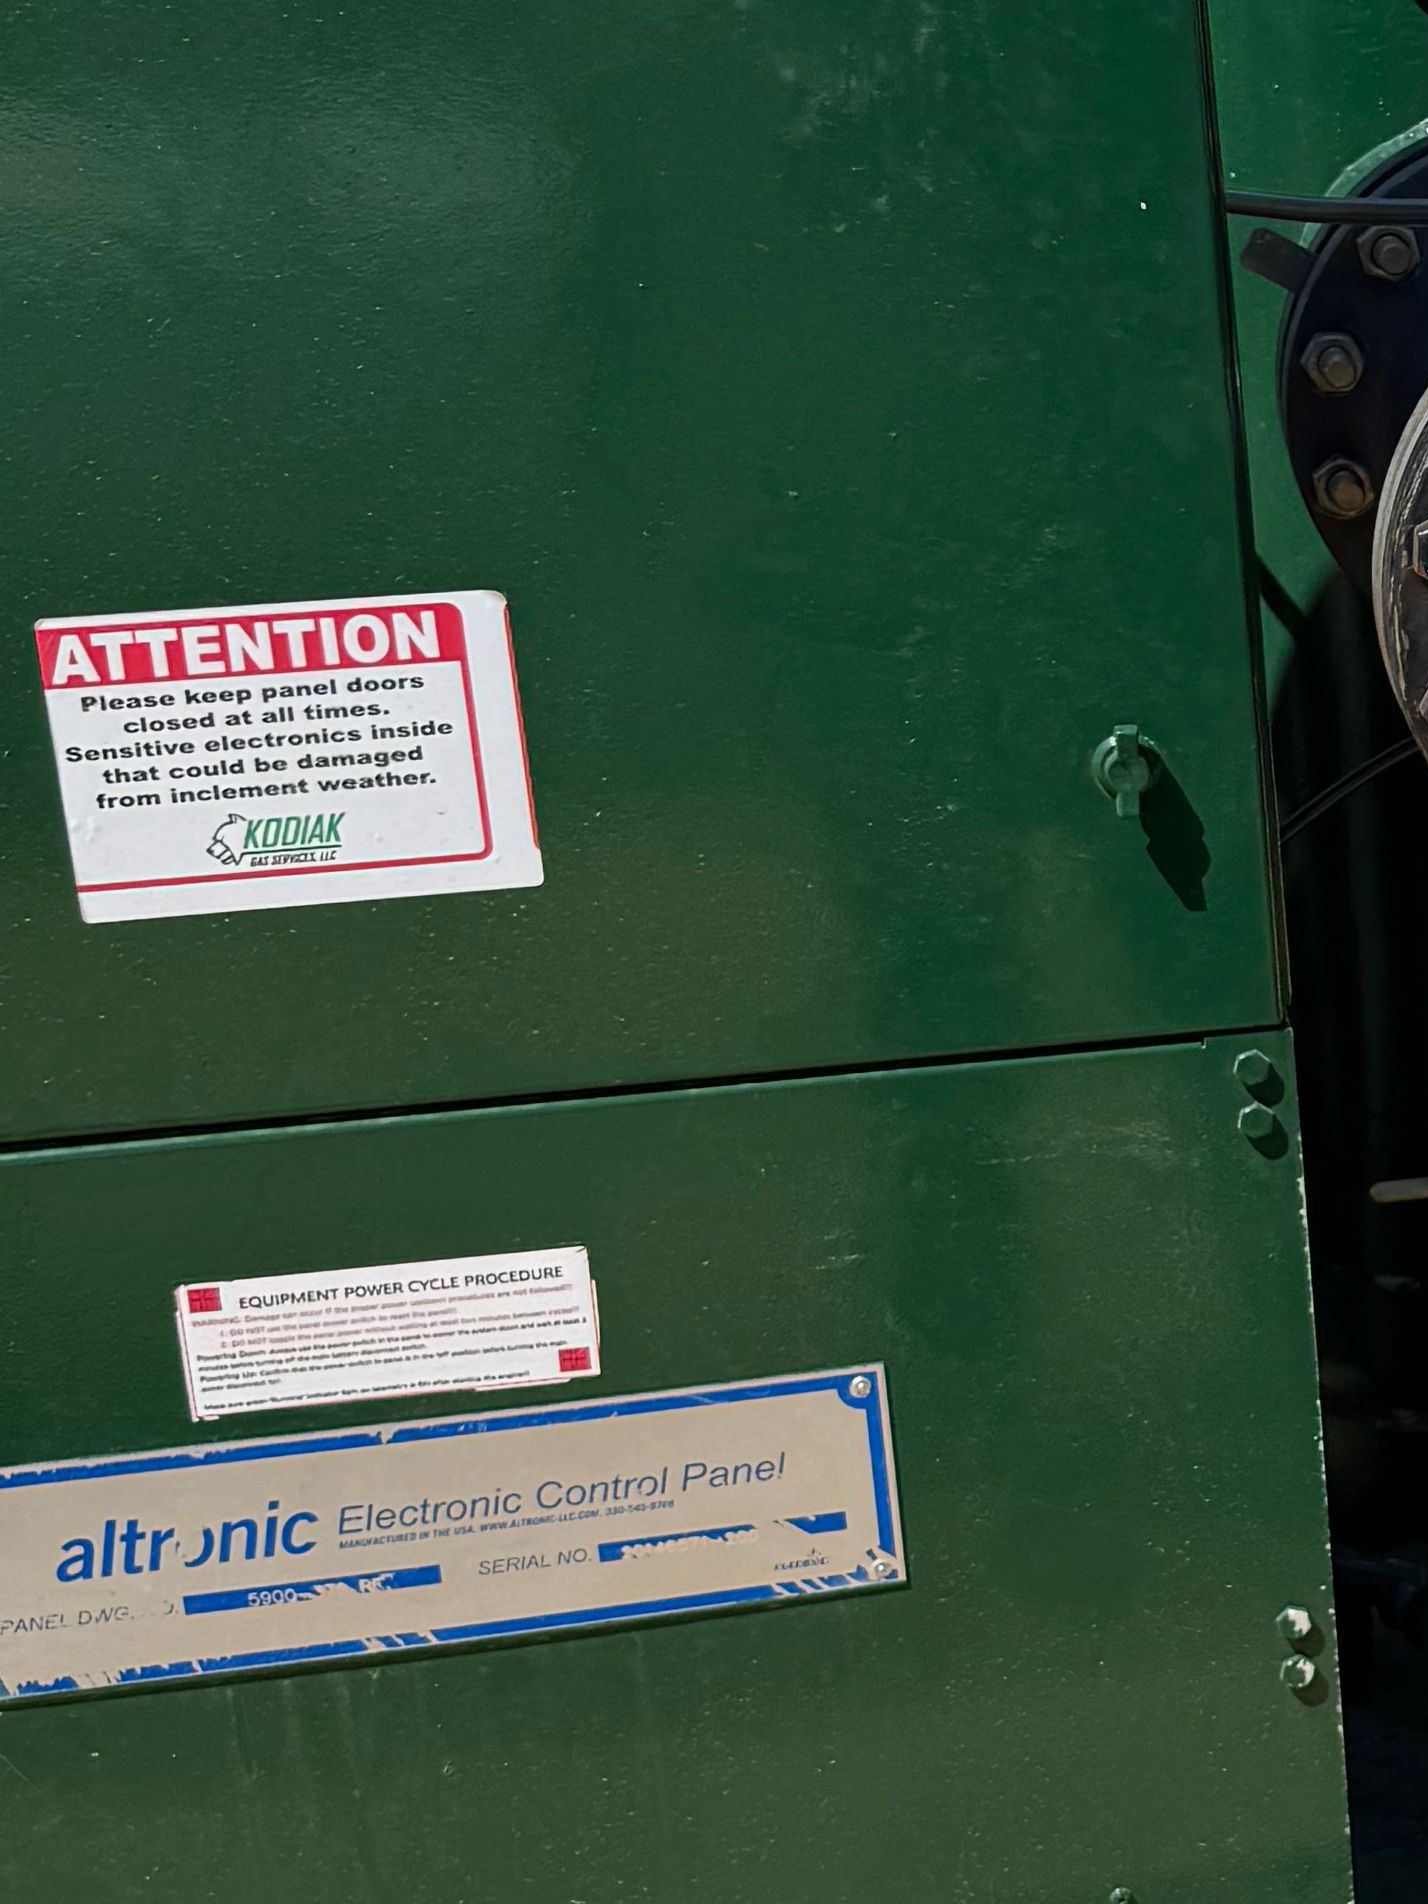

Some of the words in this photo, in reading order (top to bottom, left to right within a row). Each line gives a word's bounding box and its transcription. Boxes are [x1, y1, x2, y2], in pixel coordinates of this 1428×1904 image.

[51, 611, 441, 686] ATTENTION
[81, 691, 176, 713] Please
[184, 687, 252, 709] keep
[261, 679, 337, 705] panel
[347, 672, 425, 694] doors
[123, 712, 215, 734] closed
[224, 711, 251, 727] at
[261, 707, 295, 725] all
[304, 702, 391, 722] times.
[65, 739, 196, 763] Sensitive
[204, 726, 362, 753] electronics
[370, 719, 454, 741] inside
[102, 766, 159, 785] that
[168, 759, 244, 780] could
[254, 754, 288, 773] be
[297, 745, 424, 773] damaged
[95, 790, 161, 810] from
[170, 776, 309, 805] inclement
[318, 768, 437, 793] weather.
[243, 812, 346, 849] KODIAK
[250, 856, 270, 867] GAS
[237, 1287, 340, 1309] EQUIPMENT
[343, 1281, 403, 1298] POWER
[407, 1275, 460, 1292] CYCLE
[463, 1265, 564, 1286] PROCEDURE
[56, 1500, 319, 1583] altronic
[338, 1485, 521, 1536] Electronic
[536, 1466, 668, 1510] Control
[682, 1451, 786, 1492] Panel
[478, 1549, 552, 1576] SERIAL
[558, 1548, 592, 1566] NO.
